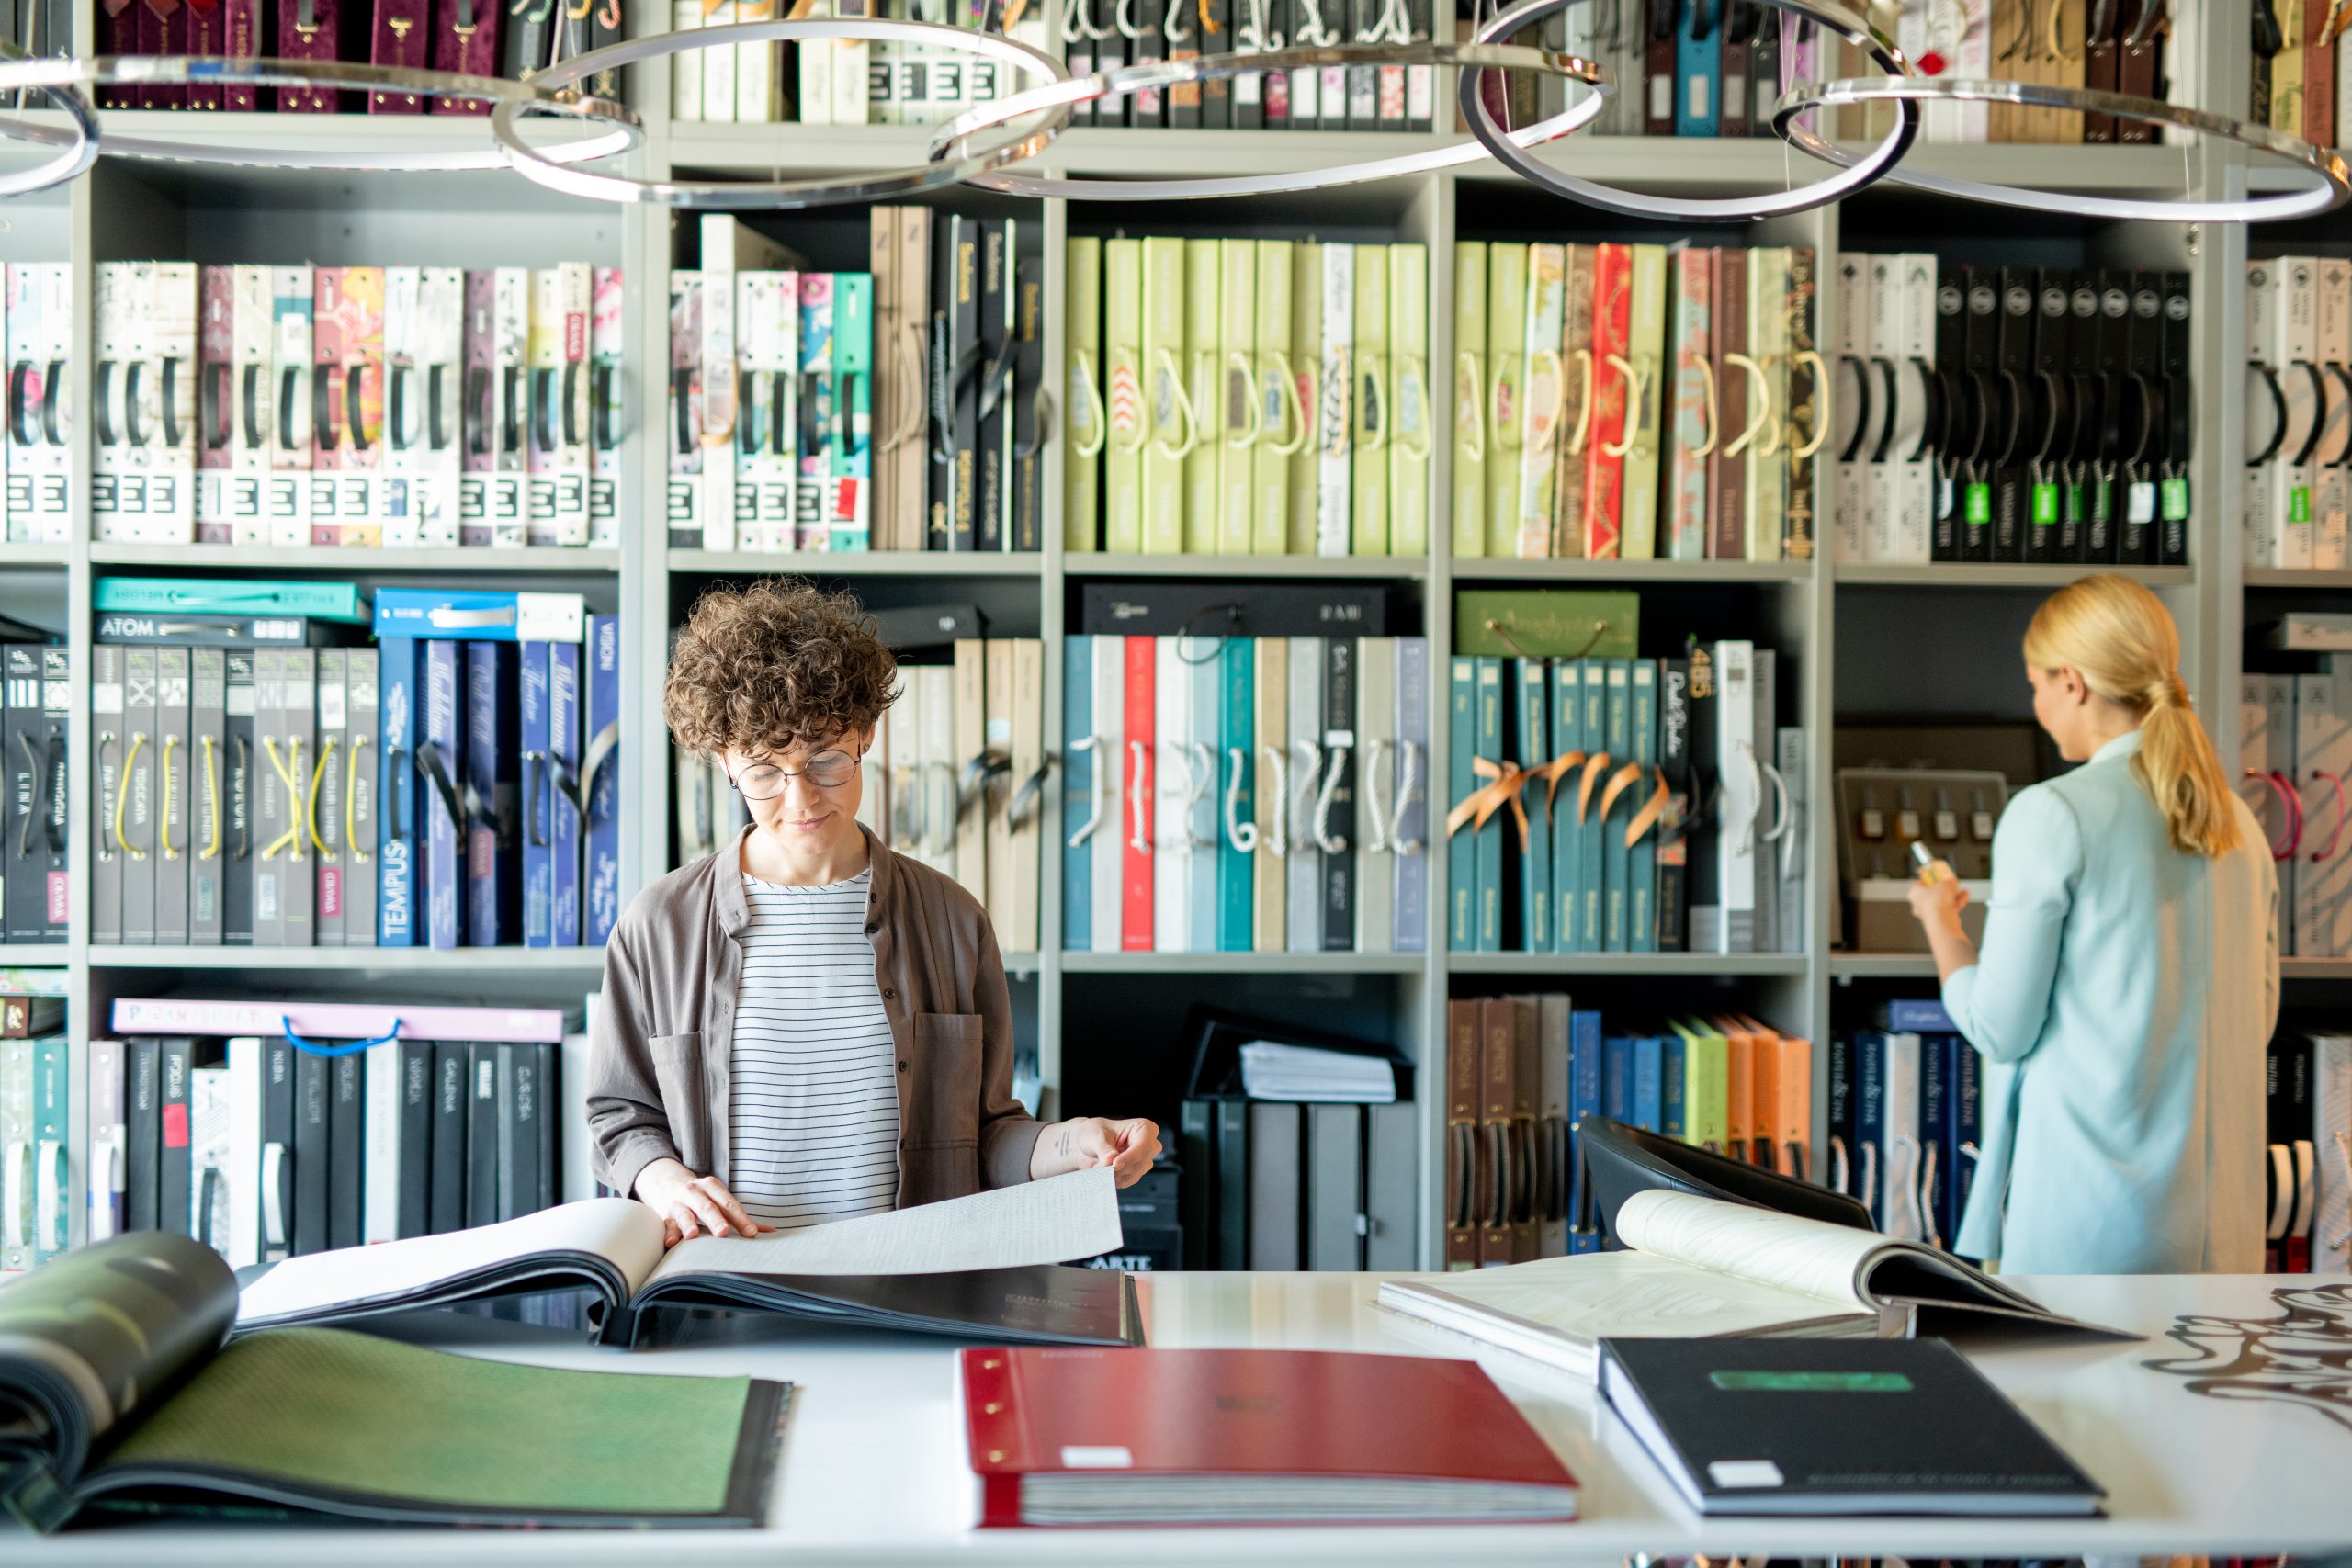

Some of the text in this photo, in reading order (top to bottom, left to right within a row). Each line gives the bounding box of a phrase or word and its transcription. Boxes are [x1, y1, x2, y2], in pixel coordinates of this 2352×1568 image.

[101, 618, 153, 636] ATOM
[19, 773, 31, 815] LINA
[384, 843, 408, 938] TEMPUS
[1088, 1256, 1152, 1271] ARTE
